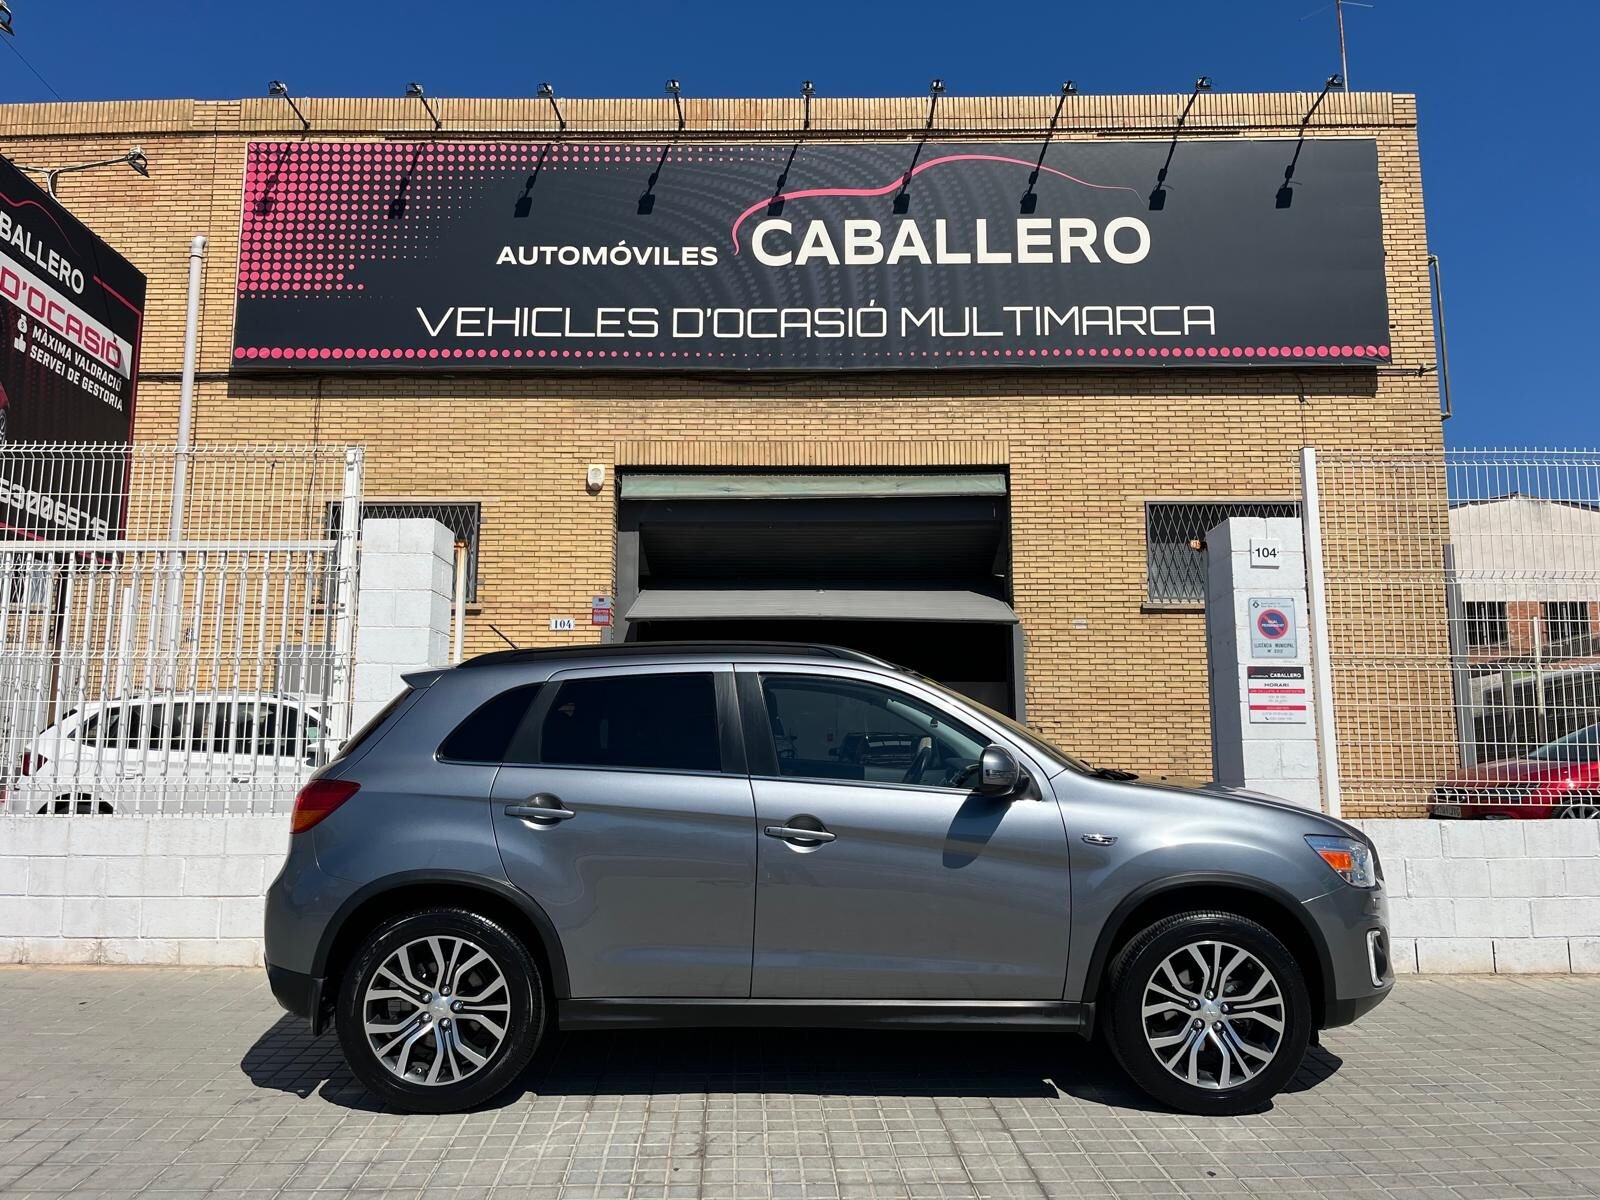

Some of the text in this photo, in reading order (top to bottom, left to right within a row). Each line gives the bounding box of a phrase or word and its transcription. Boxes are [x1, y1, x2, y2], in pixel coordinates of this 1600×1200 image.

[0, 210, 85, 294] BALLERO
[496, 216, 1151, 267] AUTOMÓVILES CABALLERO
[416, 299, 1216, 338] VEHICLES D'OCASIÓ MULTIMARCA
[29, 344, 123, 411] SERVEI DE GESTORIA
[32, 325, 122, 392] MÀXIMA VALORACIÓ
[1255, 547, 1278, 558] 104
[554, 620, 572, 629] 104
